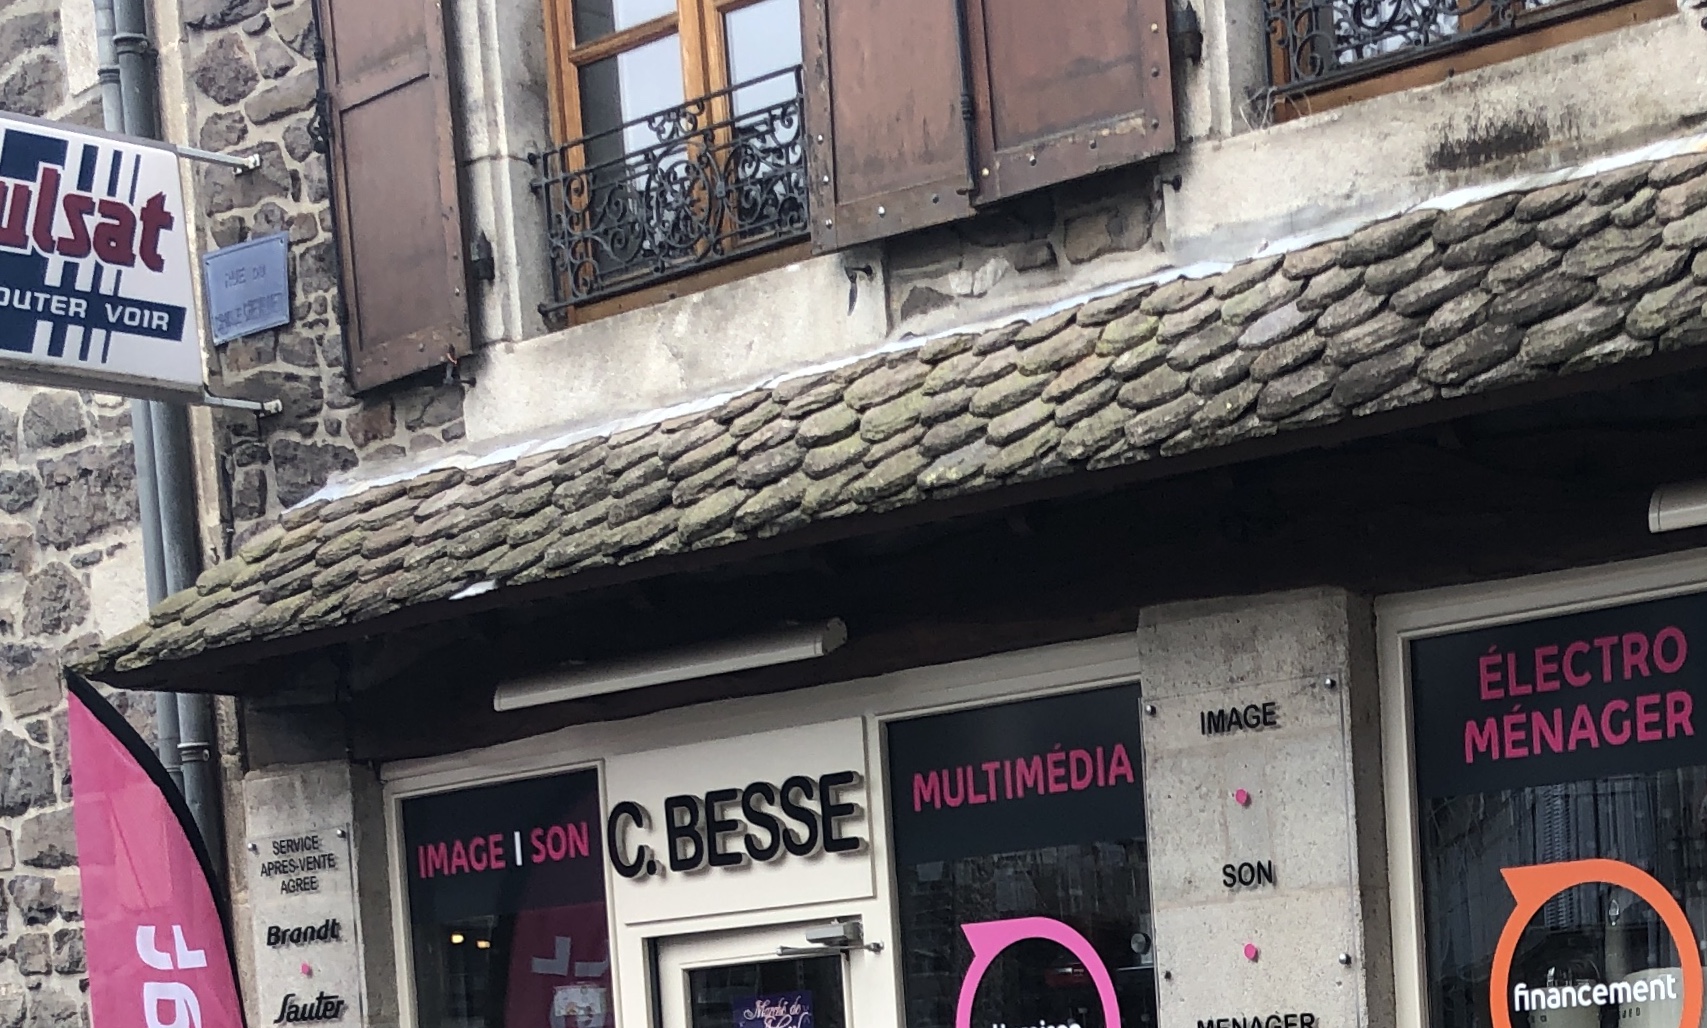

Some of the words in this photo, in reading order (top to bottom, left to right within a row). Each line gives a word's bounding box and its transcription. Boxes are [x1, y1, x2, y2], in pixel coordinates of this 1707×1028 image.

[105, 303, 170, 331] VOIR
[1479, 626, 1688, 700] ÉLECTRO
[1200, 702, 1278, 736] IMAGE
[1464, 691, 1695, 764] MÉNAGER
[913, 743, 1135, 812] MULTIMÉDIA
[607, 801, 657, 878] C.
[665, 770, 862, 872] BESSE
[272, 835, 319, 856] SERVICE
[418, 834, 505, 878] IMAGE
[530, 821, 590, 865] SON
[261, 853, 337, 877] APRES-VENTE
[1222, 860, 1273, 888] SON
[281, 876, 318, 894] AGREE
[267, 919, 340, 945] Brandt
[274, 991, 345, 1024] Sauter
[1513, 974, 1678, 1012] financement
